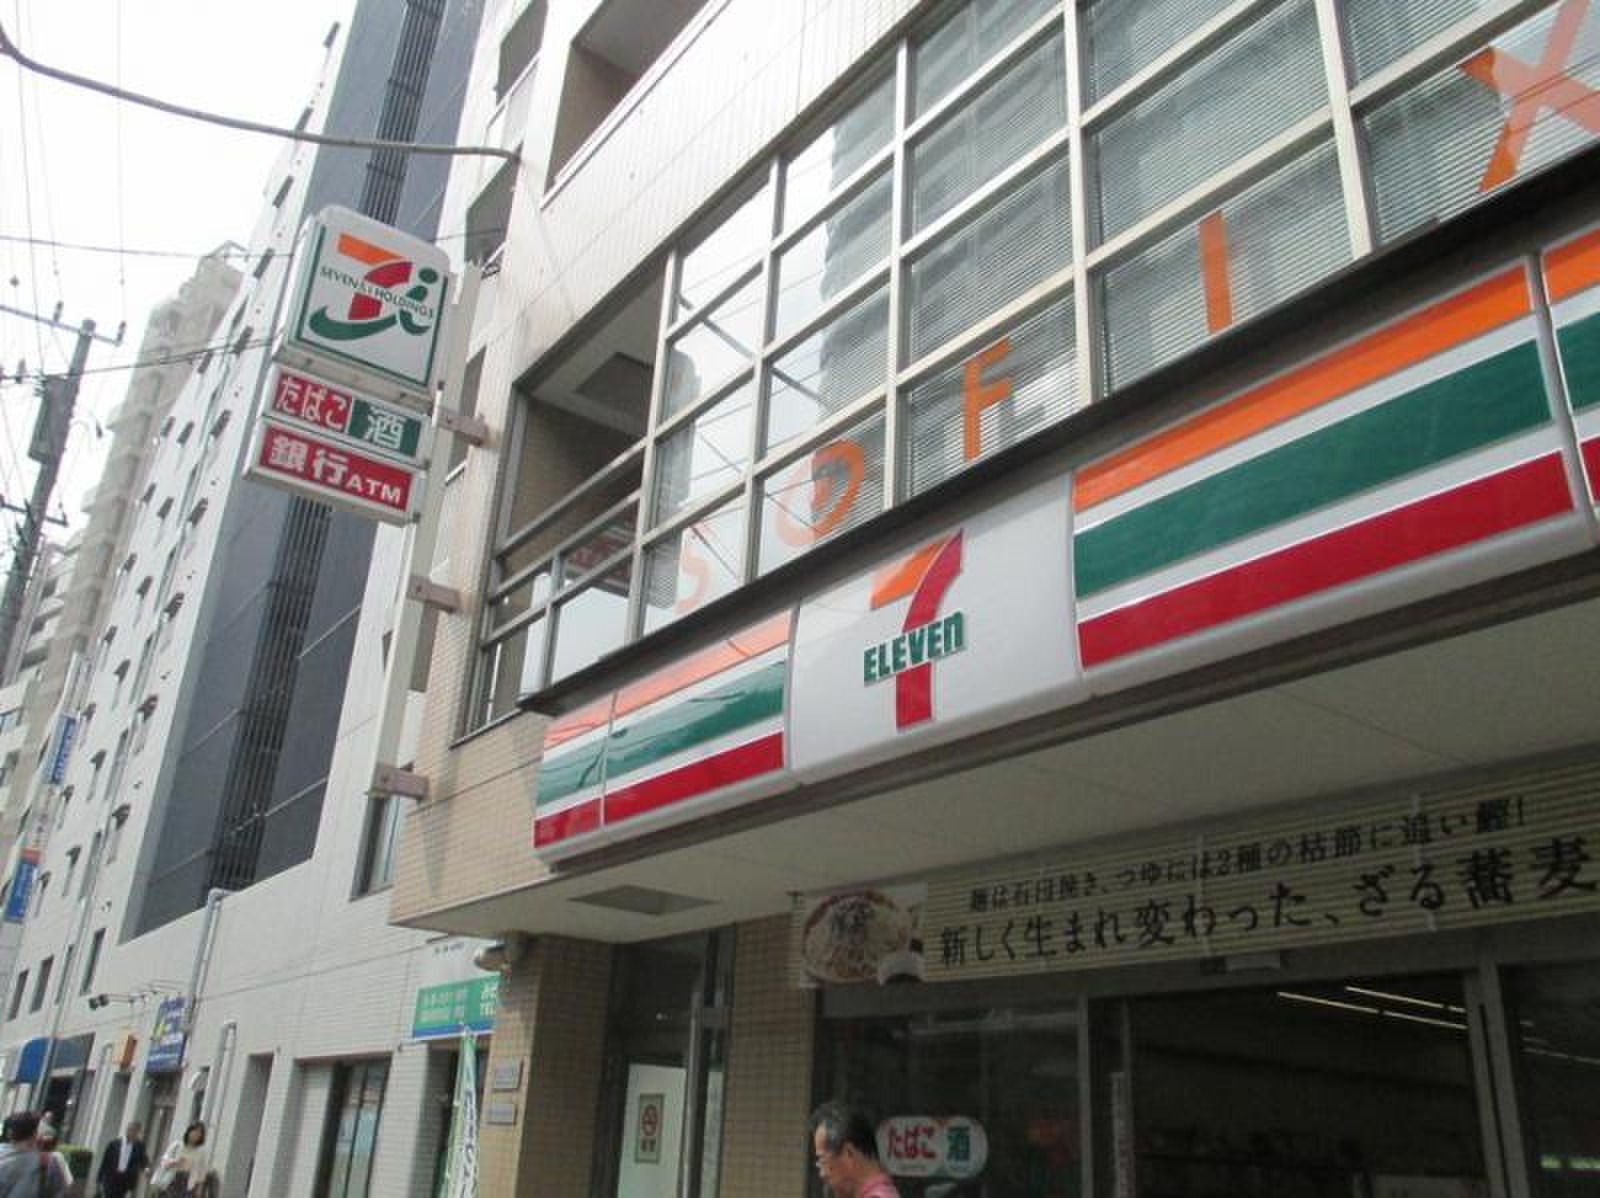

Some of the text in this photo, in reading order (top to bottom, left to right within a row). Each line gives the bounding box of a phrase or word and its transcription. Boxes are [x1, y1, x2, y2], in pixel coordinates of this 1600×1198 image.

[276, 376, 406, 449] たばこ 酒
[268, 435, 401, 504] 銀行ATM
[887, 1125, 939, 1160] たばこ
